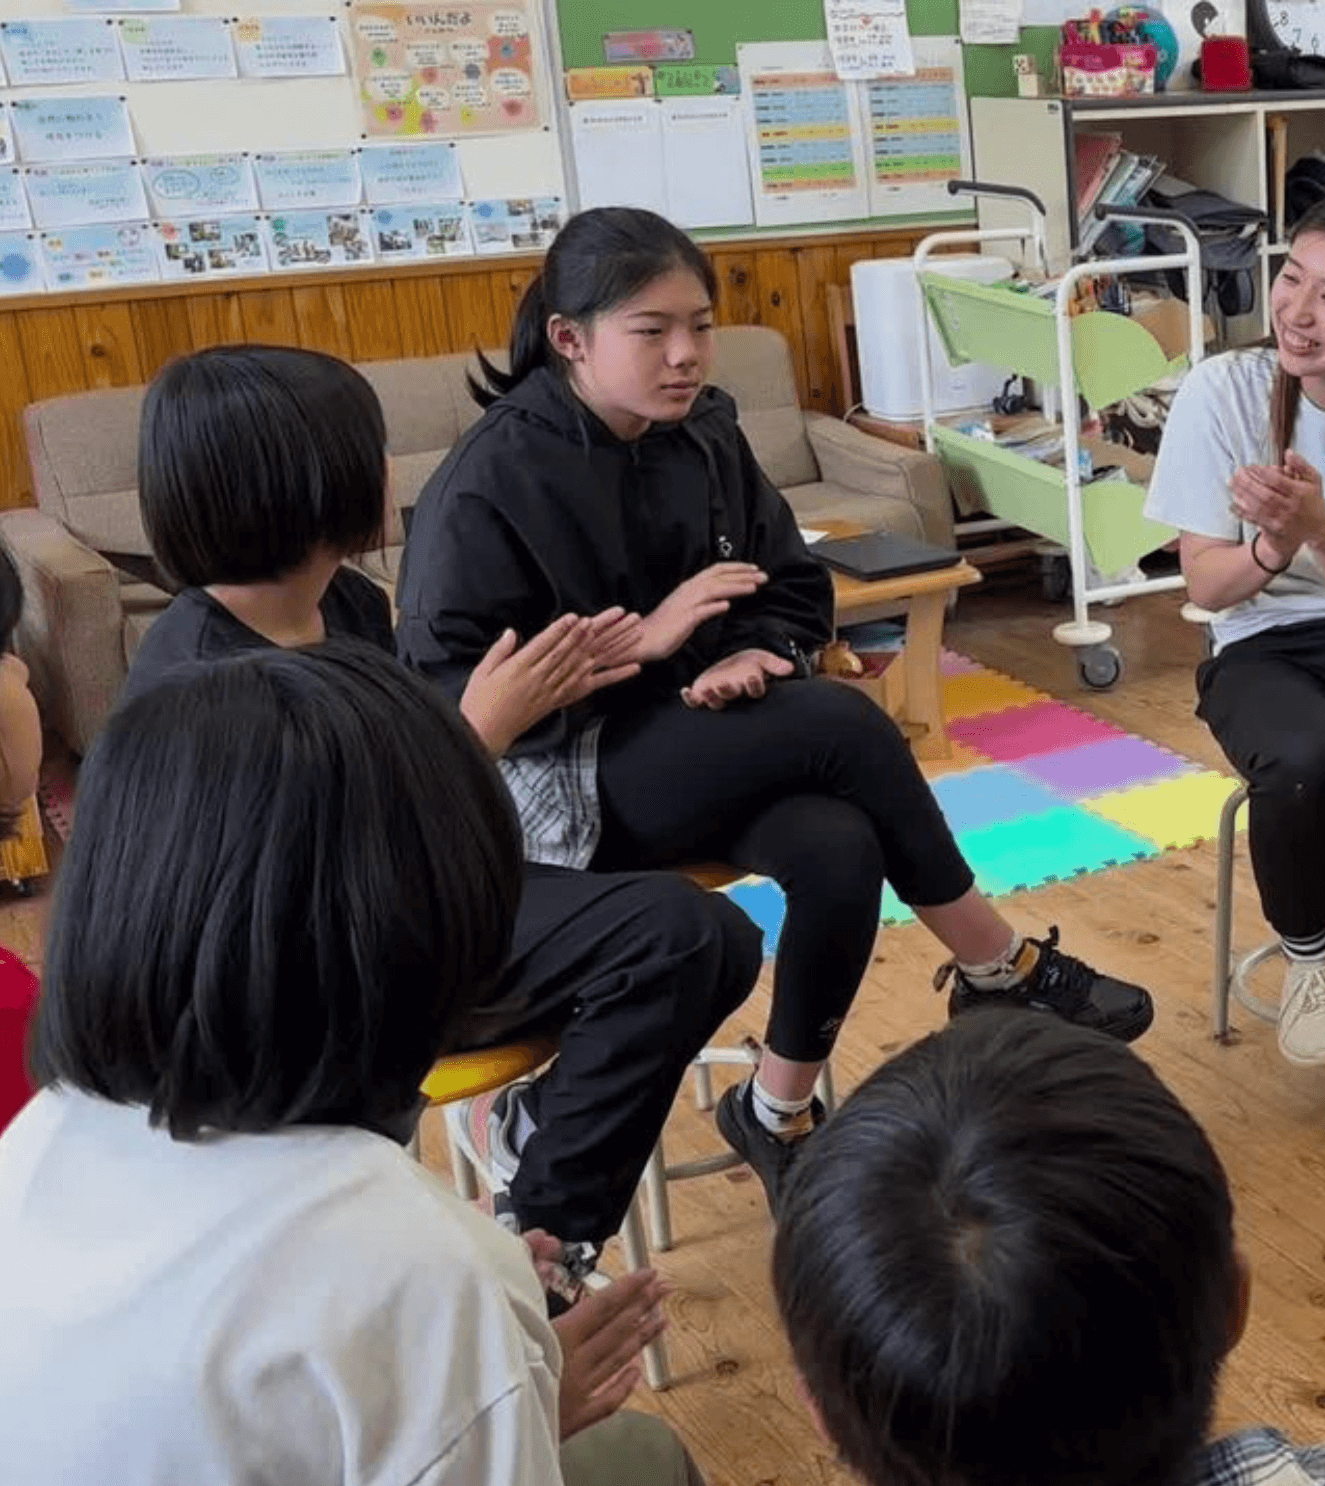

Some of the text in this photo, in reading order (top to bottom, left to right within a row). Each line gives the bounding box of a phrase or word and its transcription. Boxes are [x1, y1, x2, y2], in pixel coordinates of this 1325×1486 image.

[1280, 10, 1289, 27] 8
[1292, 27, 1302, 42] 7
[1311, 33, 1319, 49] 6
